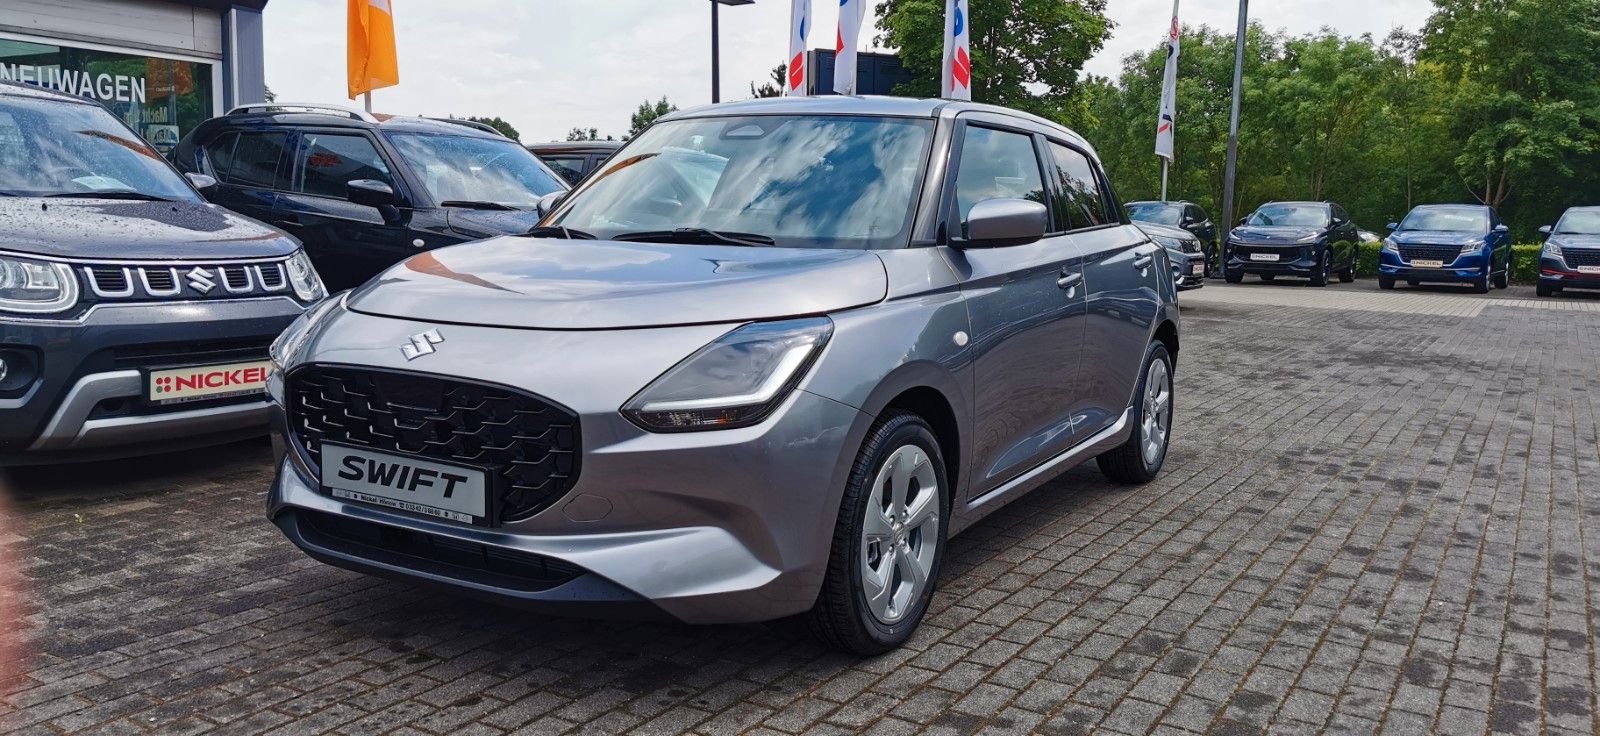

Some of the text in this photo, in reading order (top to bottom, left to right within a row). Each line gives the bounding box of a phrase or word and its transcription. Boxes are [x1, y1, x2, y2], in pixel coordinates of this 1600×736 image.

[0, 62, 146, 103] NEUWAGEN
[175, 367, 266, 391] NICKEL
[338, 455, 468, 498] SWIFT
